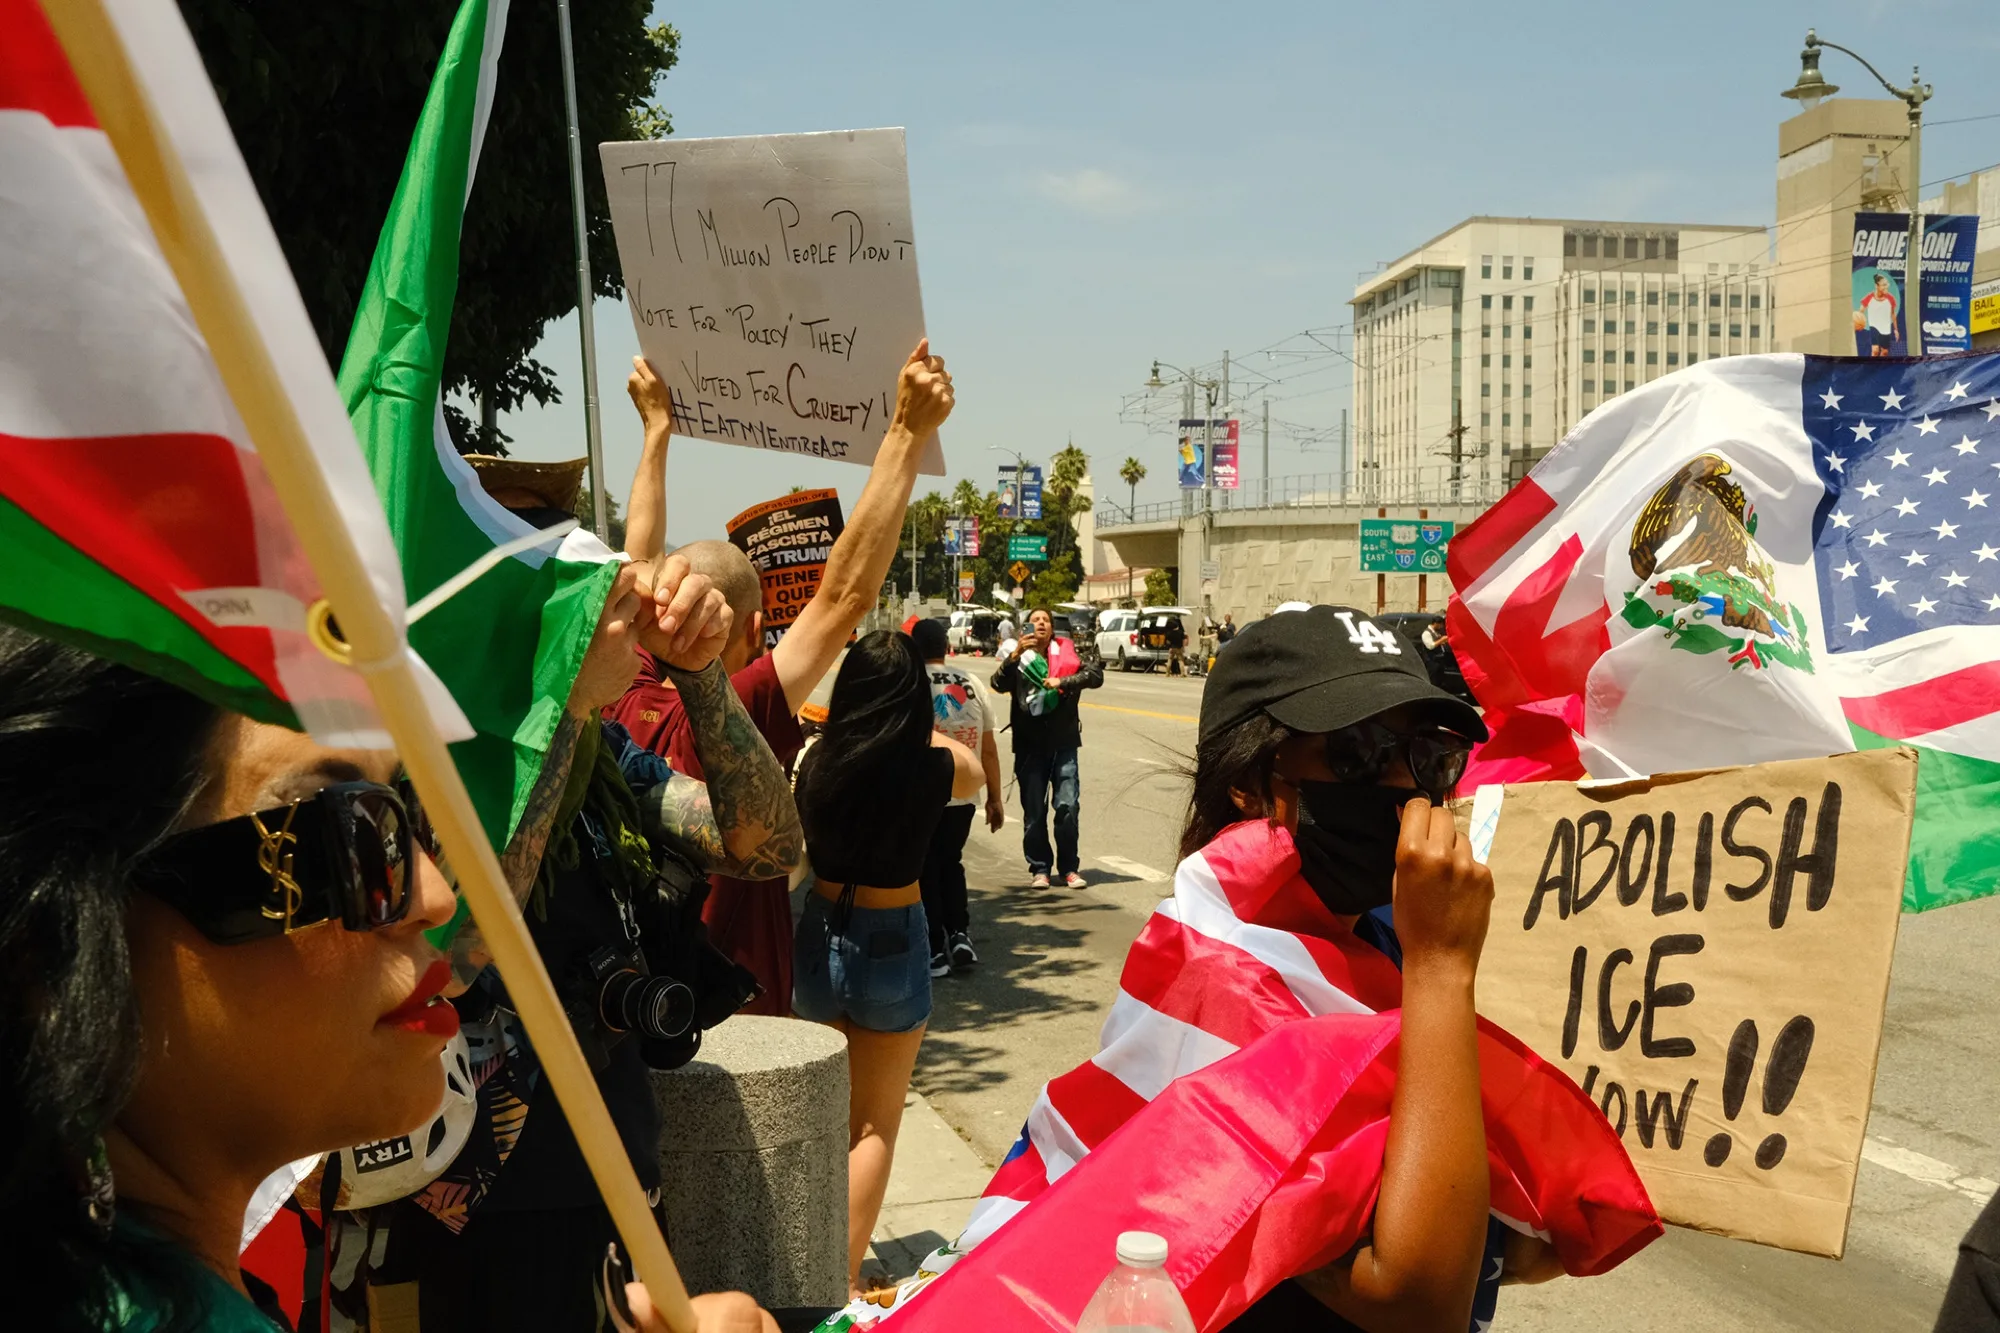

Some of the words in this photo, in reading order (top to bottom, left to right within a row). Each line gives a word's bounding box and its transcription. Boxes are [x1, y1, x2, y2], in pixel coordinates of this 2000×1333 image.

[621, 162, 683, 263] 77
[697, 208, 770, 267] MILLION
[763, 197, 837, 264] PEOPLE
[1852, 230, 1909, 257] GAME
[1922, 232, 1958, 259] ON!
[1951, 262, 1971, 272] PLAY
[1972, 283, 2000, 298] onzales
[1974, 298, 1995, 311] BAIL
[628, 278, 678, 328] VOTE
[688, 305, 721, 333] FOR
[800, 318, 857, 361] THEY
[682, 350, 741, 400] VOTED
[746, 371, 784, 406] FOR
[746, 515, 830, 547] RÉGIMEN
[1364, 529, 1389, 537] SOUTH
[1428, 531, 1435, 541] 5
[746, 530, 833, 560] FASCISTA
[1366, 553, 1386, 562] EAST
[1400, 554, 1411, 564] 10
[1424, 555, 1438, 565] 60
[764, 569, 820, 589] TIENE
[776, 585, 816, 604] QUE
[1333, 611, 1402, 655] LA
[931, 673, 976, 700] KYO
[1523, 781, 1842, 930] ABOLISH
[597, 953, 616, 970] SONY
[1560, 933, 1706, 1060] ICE
[358, 1141, 410, 1168] TRY
